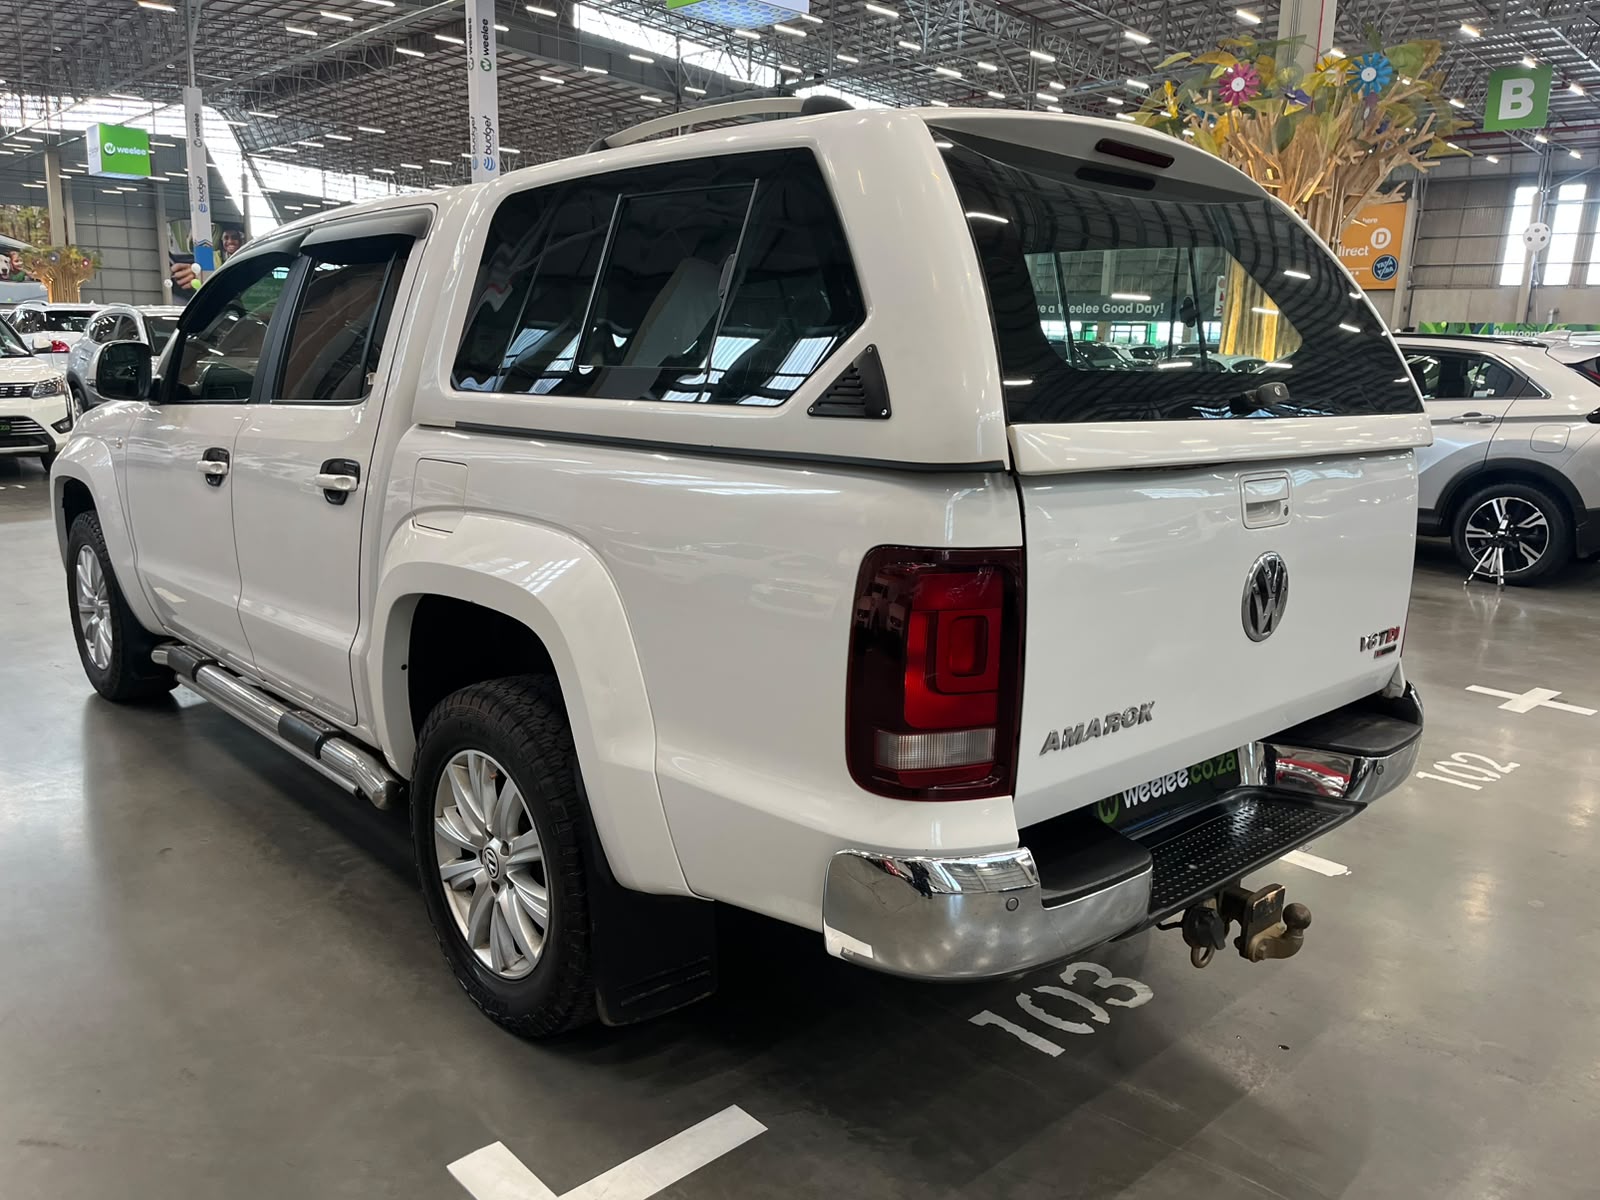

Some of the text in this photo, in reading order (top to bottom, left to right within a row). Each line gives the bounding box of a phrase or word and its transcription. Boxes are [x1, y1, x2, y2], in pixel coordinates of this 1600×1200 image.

[481, 18, 489, 56] weelee
[1498, 78, 1535, 120] B
[117, 147, 147, 156] weelee
[482, 115, 495, 155] budget
[1048, 305, 1055, 314] a
[1102, 303, 1133, 314] Good
[1136, 303, 1164, 318] Day!
[1039, 700, 1155, 756] AMAROK
[1415, 752, 1521, 791] 102
[967, 961, 1154, 1058] 103
